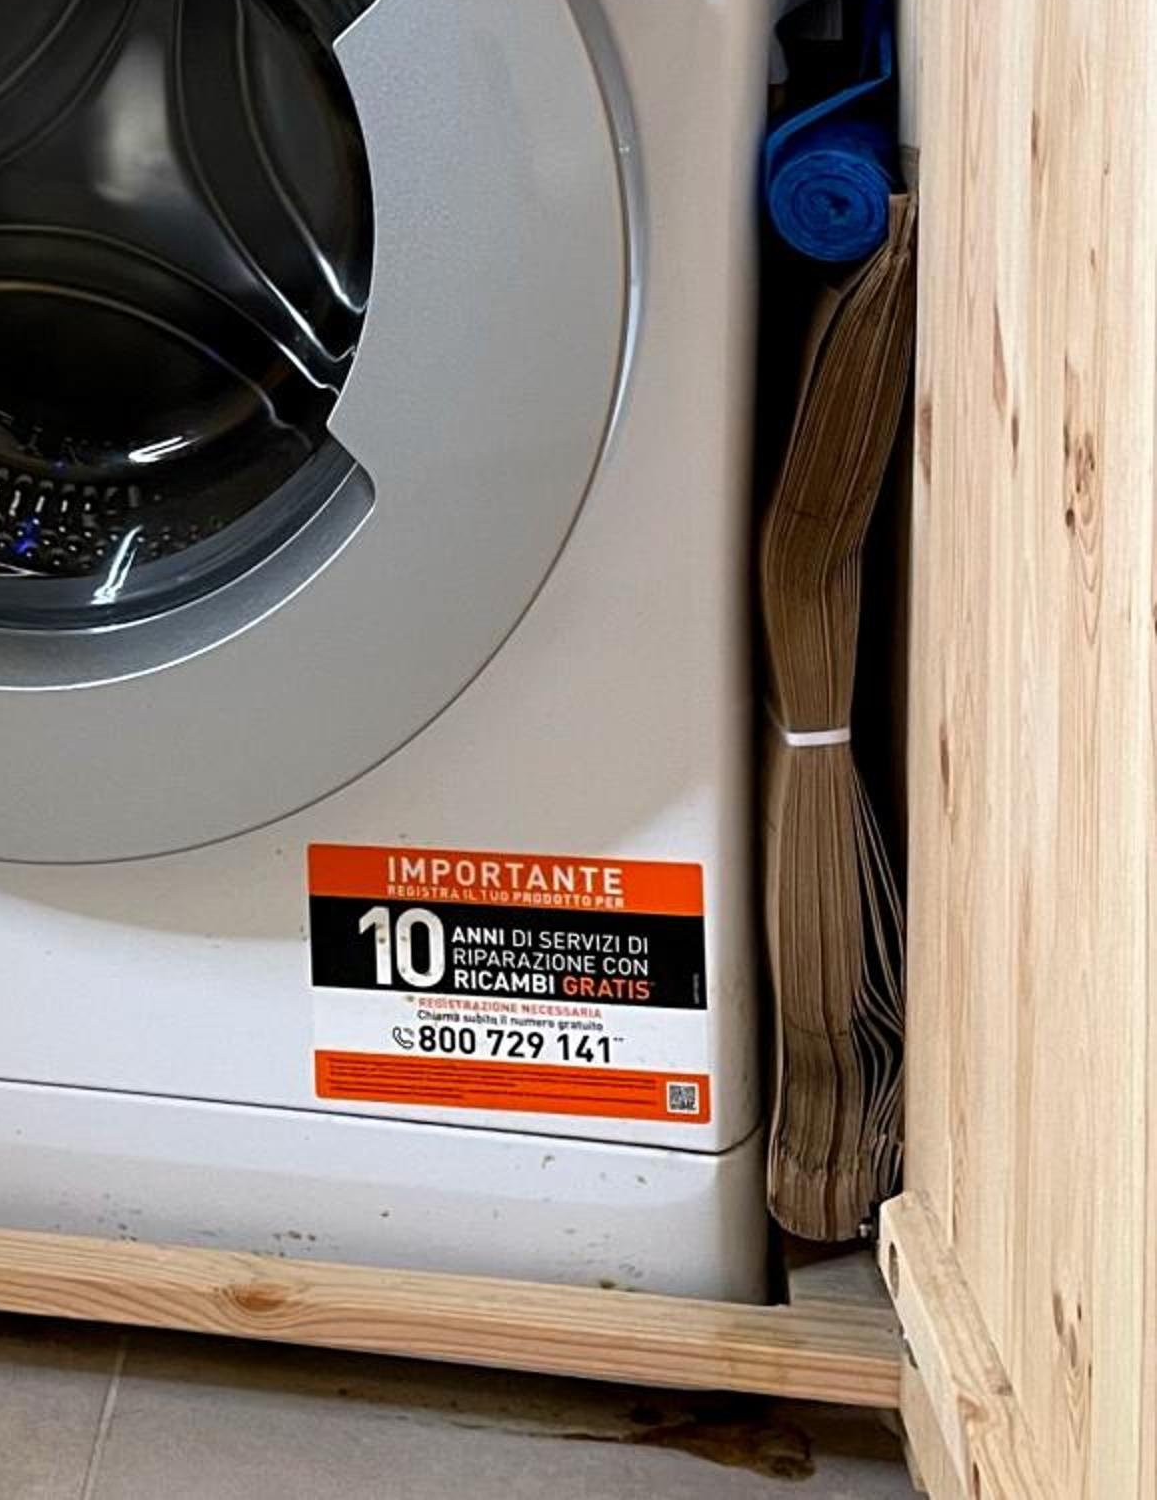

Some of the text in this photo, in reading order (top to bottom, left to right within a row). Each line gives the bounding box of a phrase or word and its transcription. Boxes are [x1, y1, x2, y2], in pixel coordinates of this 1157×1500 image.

[388, 856, 624, 895] IMPORTANTE
[388, 884, 624, 908] REGISTRA IL TUO PRODOTTO PER
[358, 905, 445, 987] 10
[452, 926, 648, 954] ANNI DI SERVIZI DI
[453, 948, 649, 977] RIPARAZIONE CON
[454, 969, 555, 994] RICAMBI
[418, 997, 602, 1018] REGISTRAZIONE NECESSARIA
[418, 1009, 603, 1032] Chiama subito il numero gratuito
[419, 1025, 475, 1054] 800
[486, 1029, 544, 1059] 729
